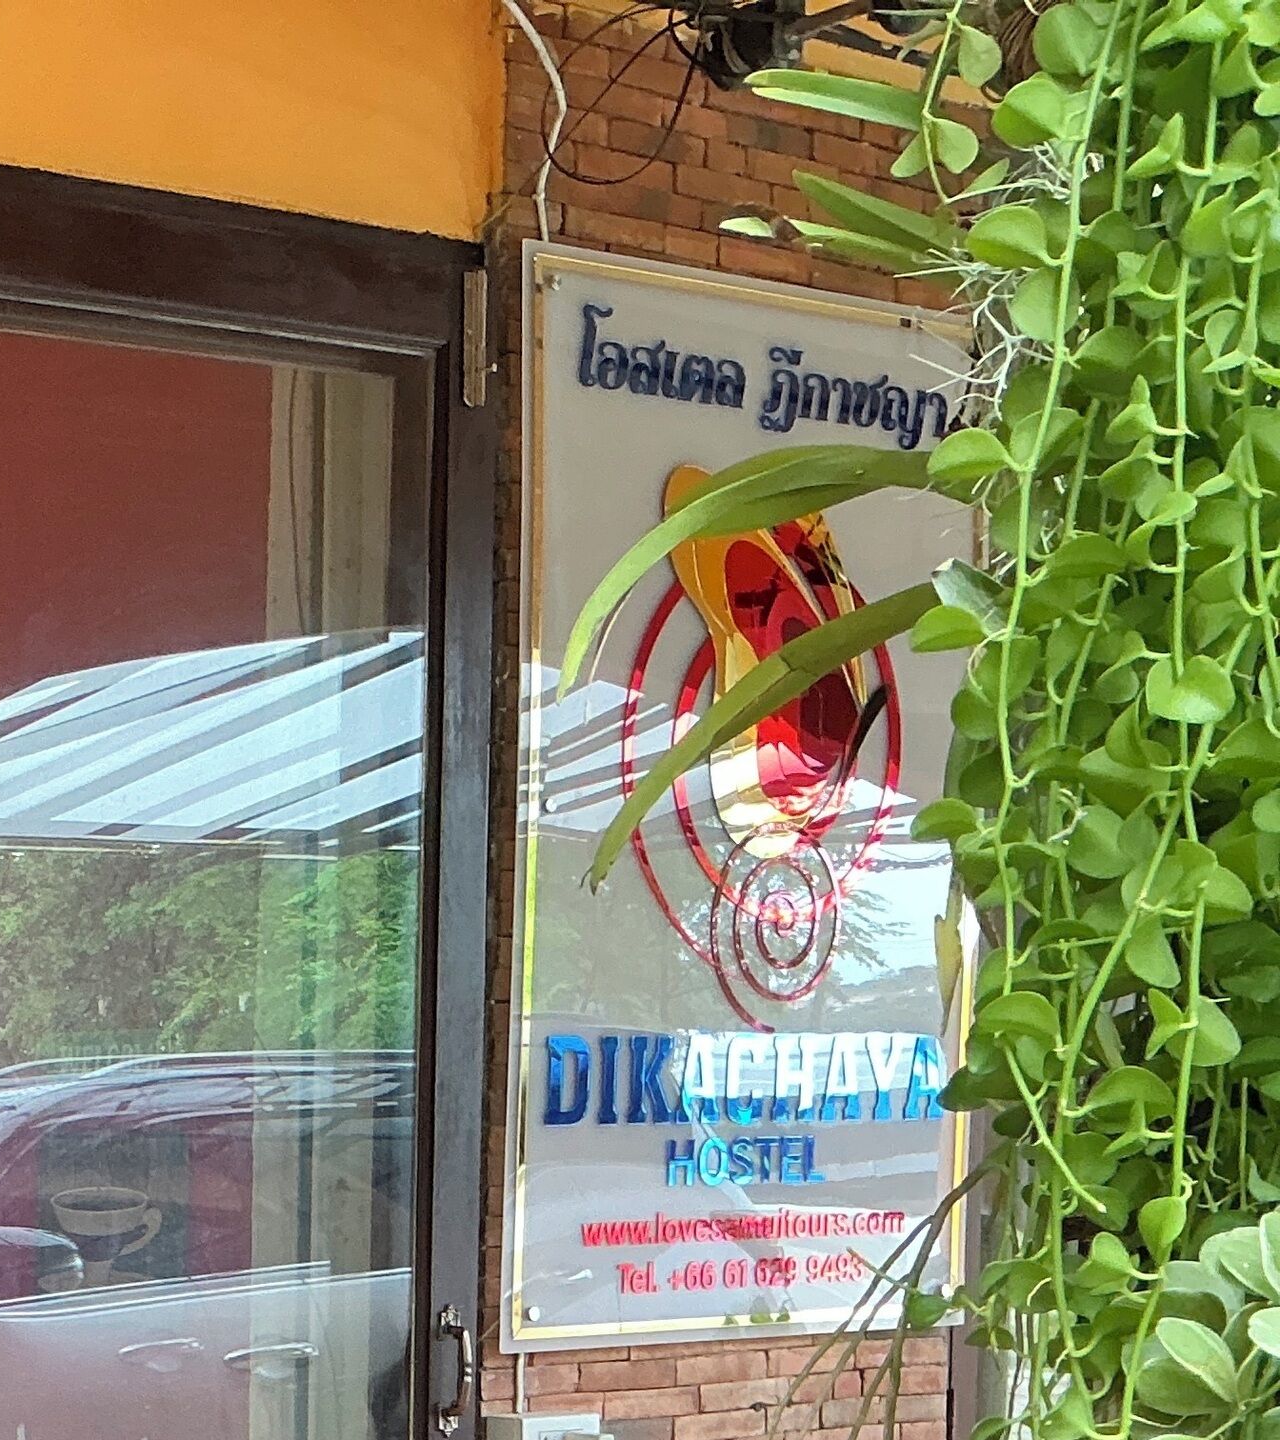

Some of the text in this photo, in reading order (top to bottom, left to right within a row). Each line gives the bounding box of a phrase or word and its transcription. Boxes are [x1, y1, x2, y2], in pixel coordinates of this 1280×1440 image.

[543, 1033, 945, 1126] DIKACHAYA
[665, 1134, 826, 1187] HOSTEL
[581, 1206, 906, 1247] www.lovesamuitours.com
[616, 1253, 866, 1294] Tel. +66 61 629 9493
